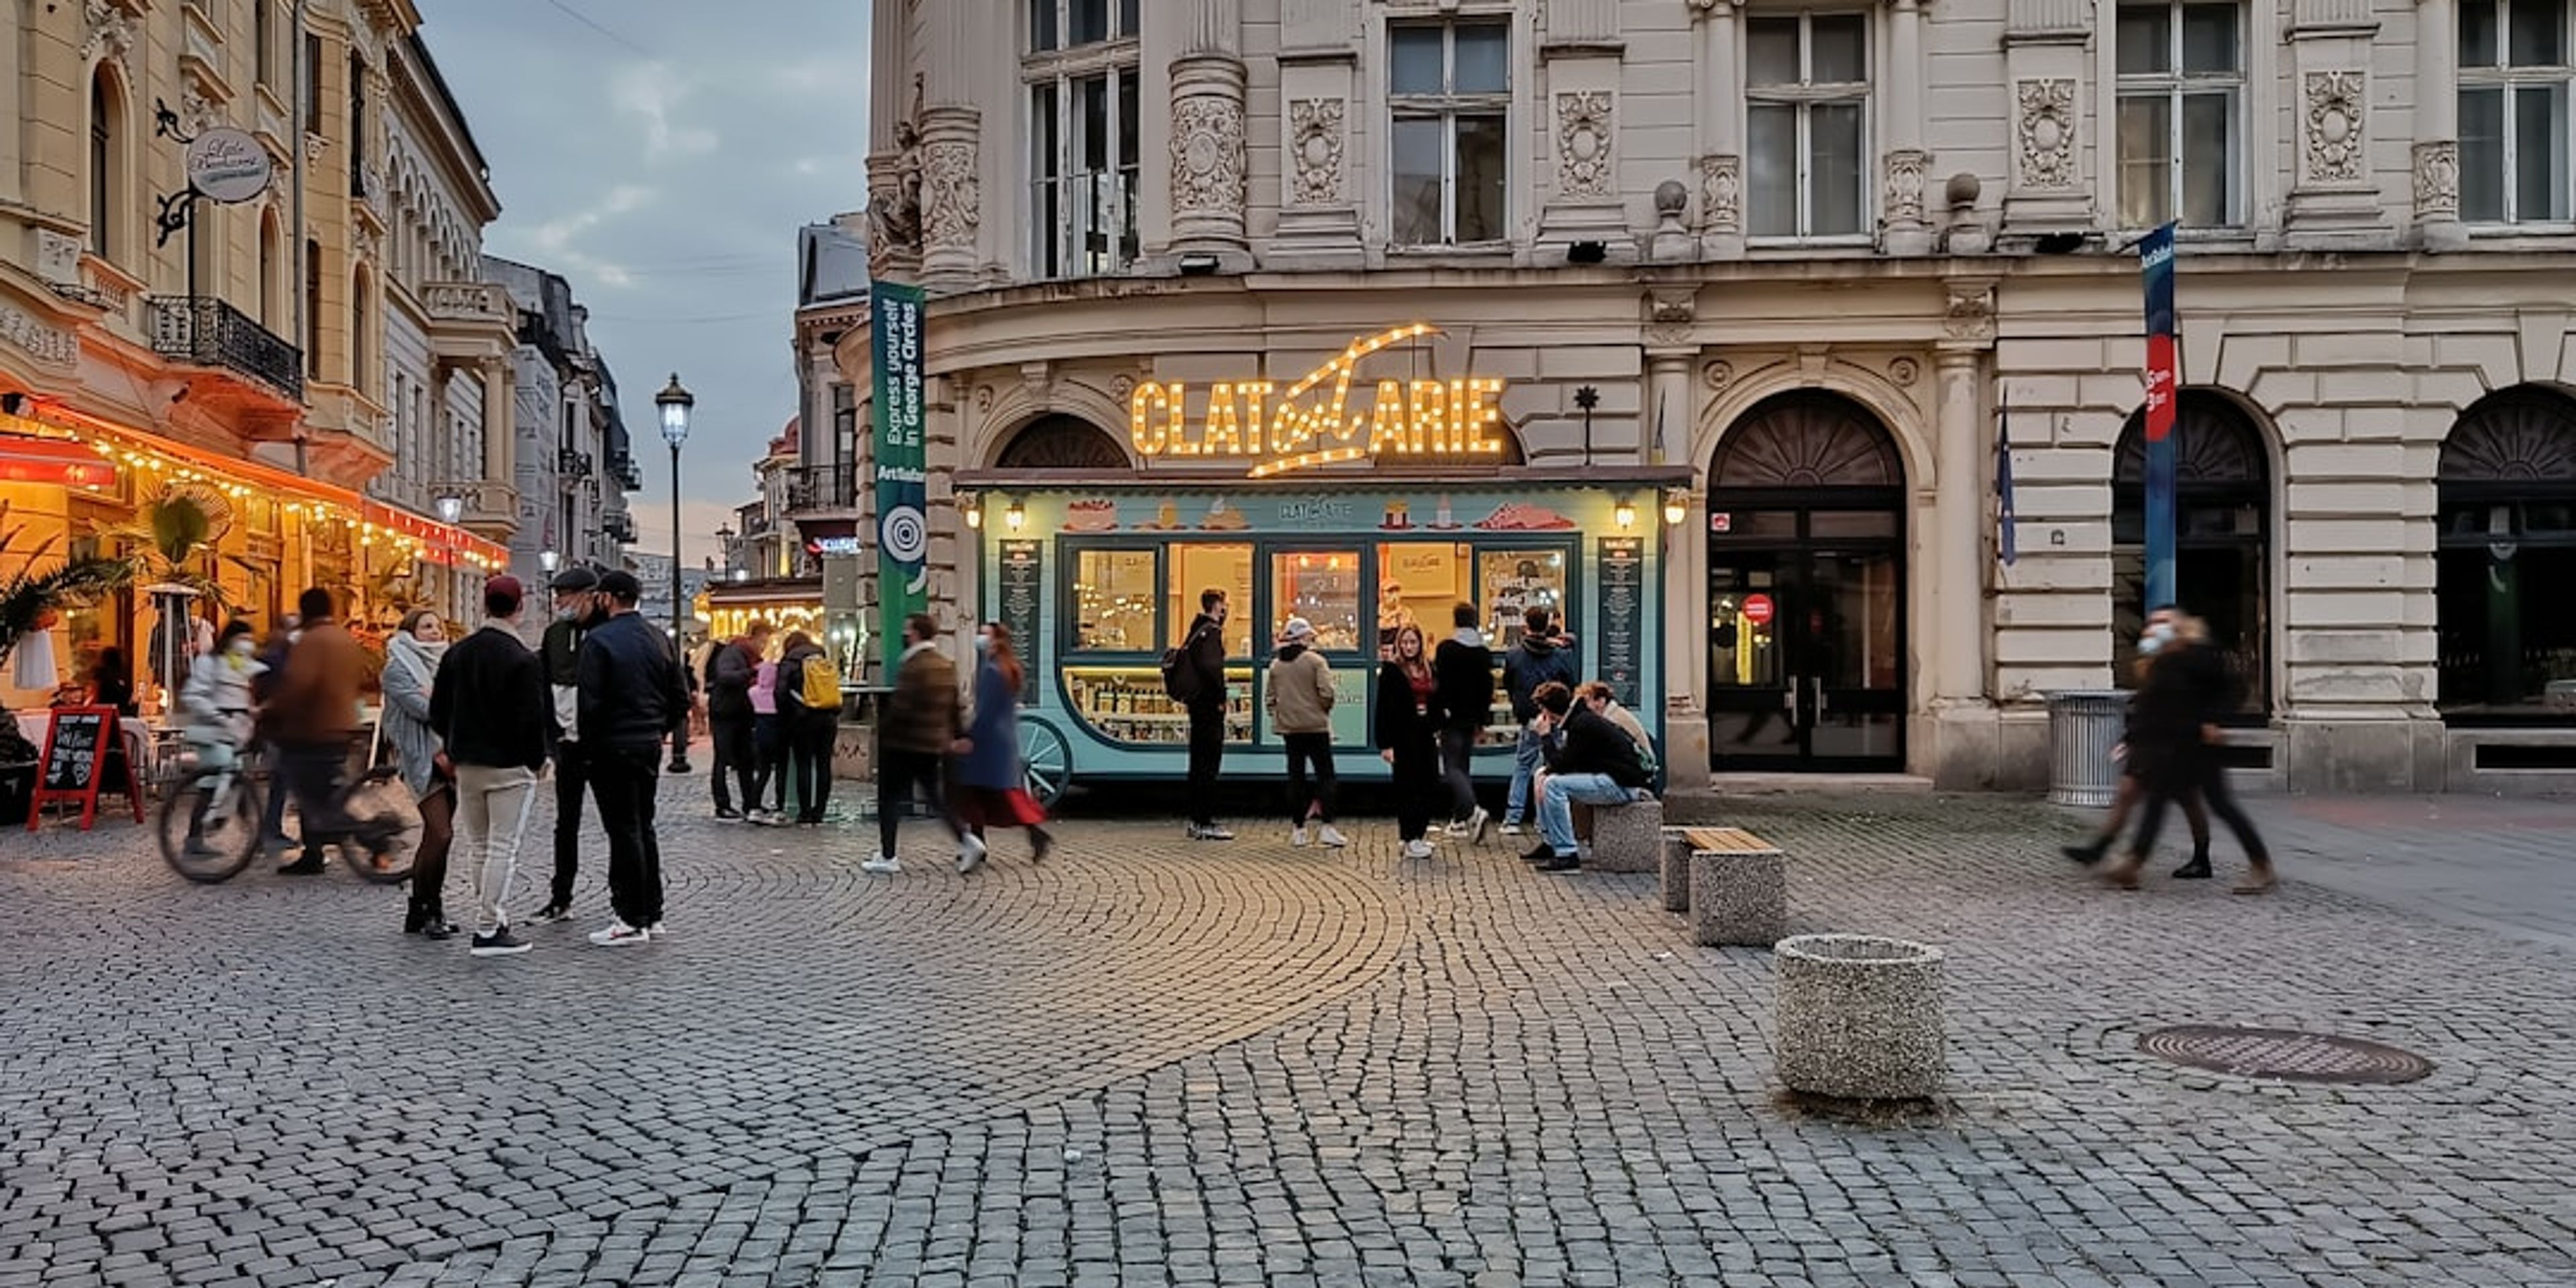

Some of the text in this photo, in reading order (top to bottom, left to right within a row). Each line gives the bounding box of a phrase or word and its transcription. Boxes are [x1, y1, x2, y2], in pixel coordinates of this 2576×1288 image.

[883, 299, 902, 445] Express yourself
[904, 362, 921, 427] George
[904, 430, 918, 447] in
[1132, 379, 1273, 455] CLAT
[1368, 379, 1504, 455] ARIE
